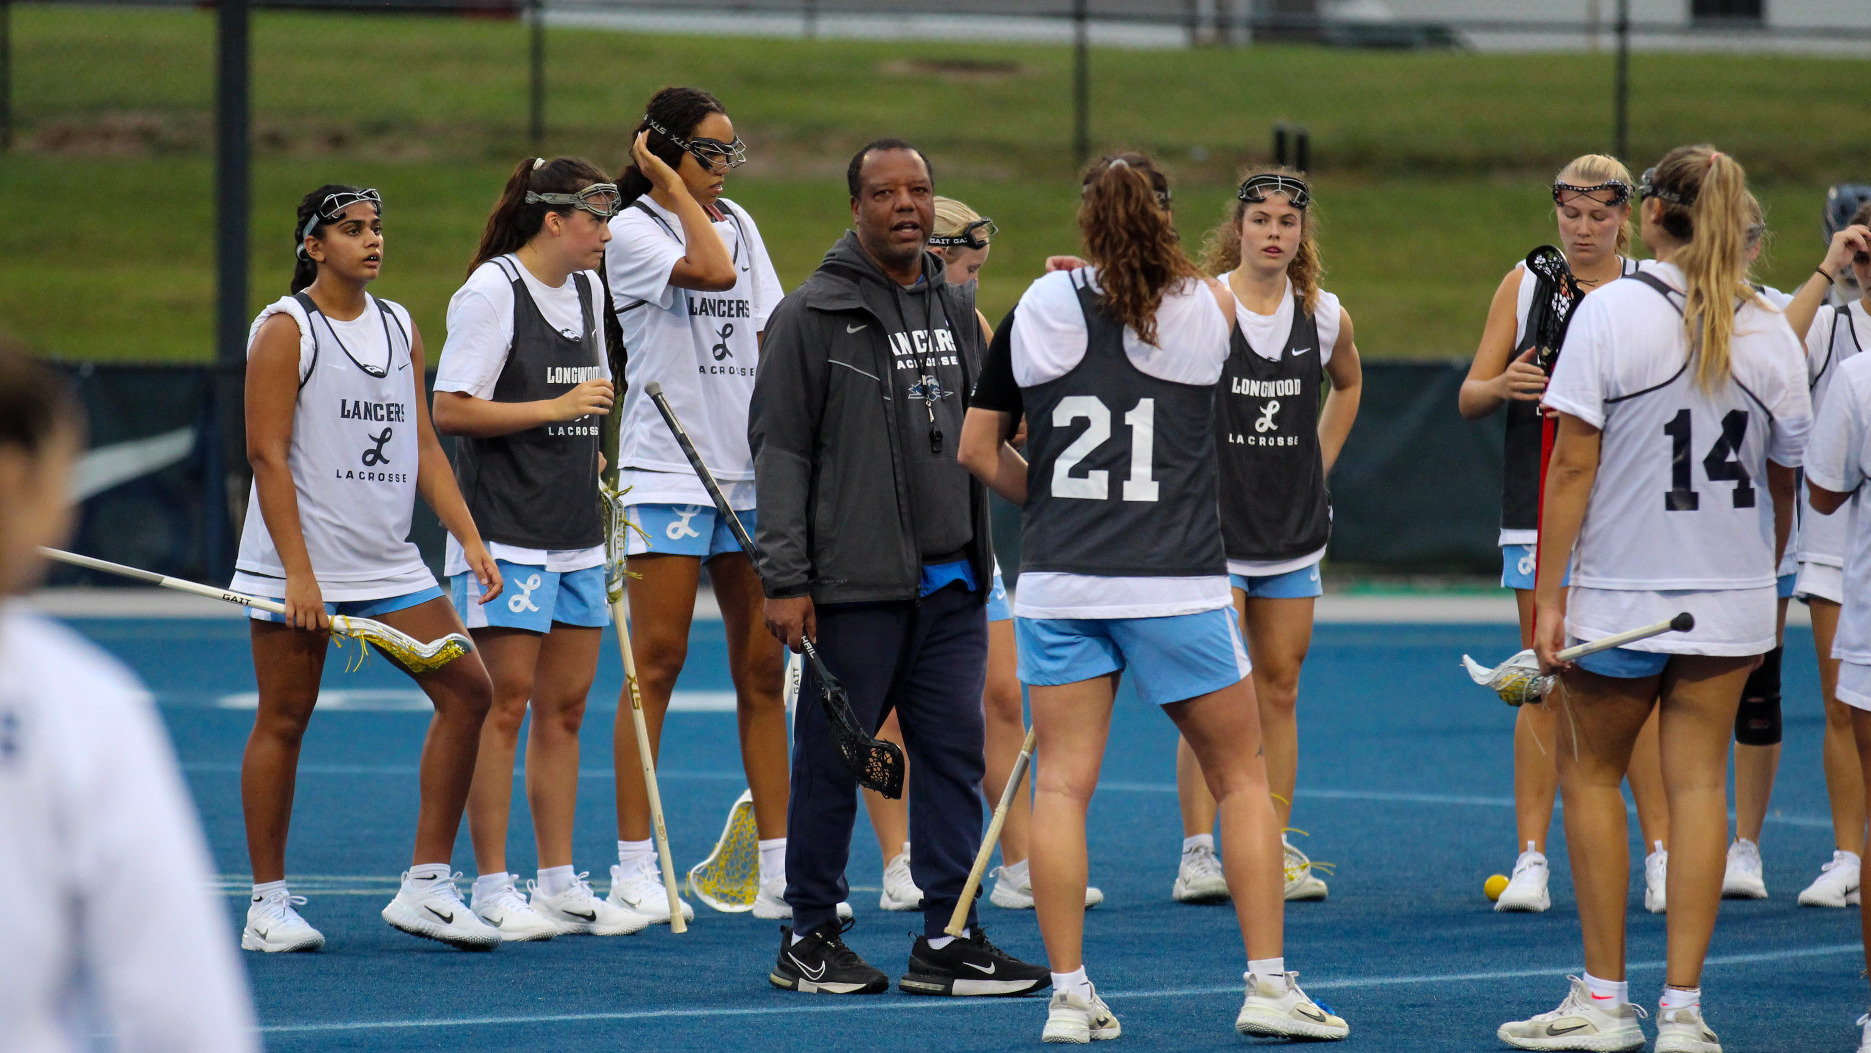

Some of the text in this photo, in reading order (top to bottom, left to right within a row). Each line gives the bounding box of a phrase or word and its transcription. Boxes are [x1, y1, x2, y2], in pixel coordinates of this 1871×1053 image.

[929, 237, 950, 245] GAIT
[689, 296, 750, 319] LANCERS
[546, 365, 600, 384] LONGWOO
[699, 365, 755, 377] ACROSE
[1231, 376, 1301, 398] LONGWOOD
[340, 399, 405, 423] LANCERS
[548, 426, 599, 436] LACROSS
[1228, 433, 1299, 447] LACROSSE
[1051, 395, 1160, 502] 21
[1664, 408, 1756, 512] 14
[336, 469, 407, 483] LACROSSE
[222, 593, 252, 606] GAIT
[792, 666, 800, 695] GAIT
[626, 673, 641, 710] STX
